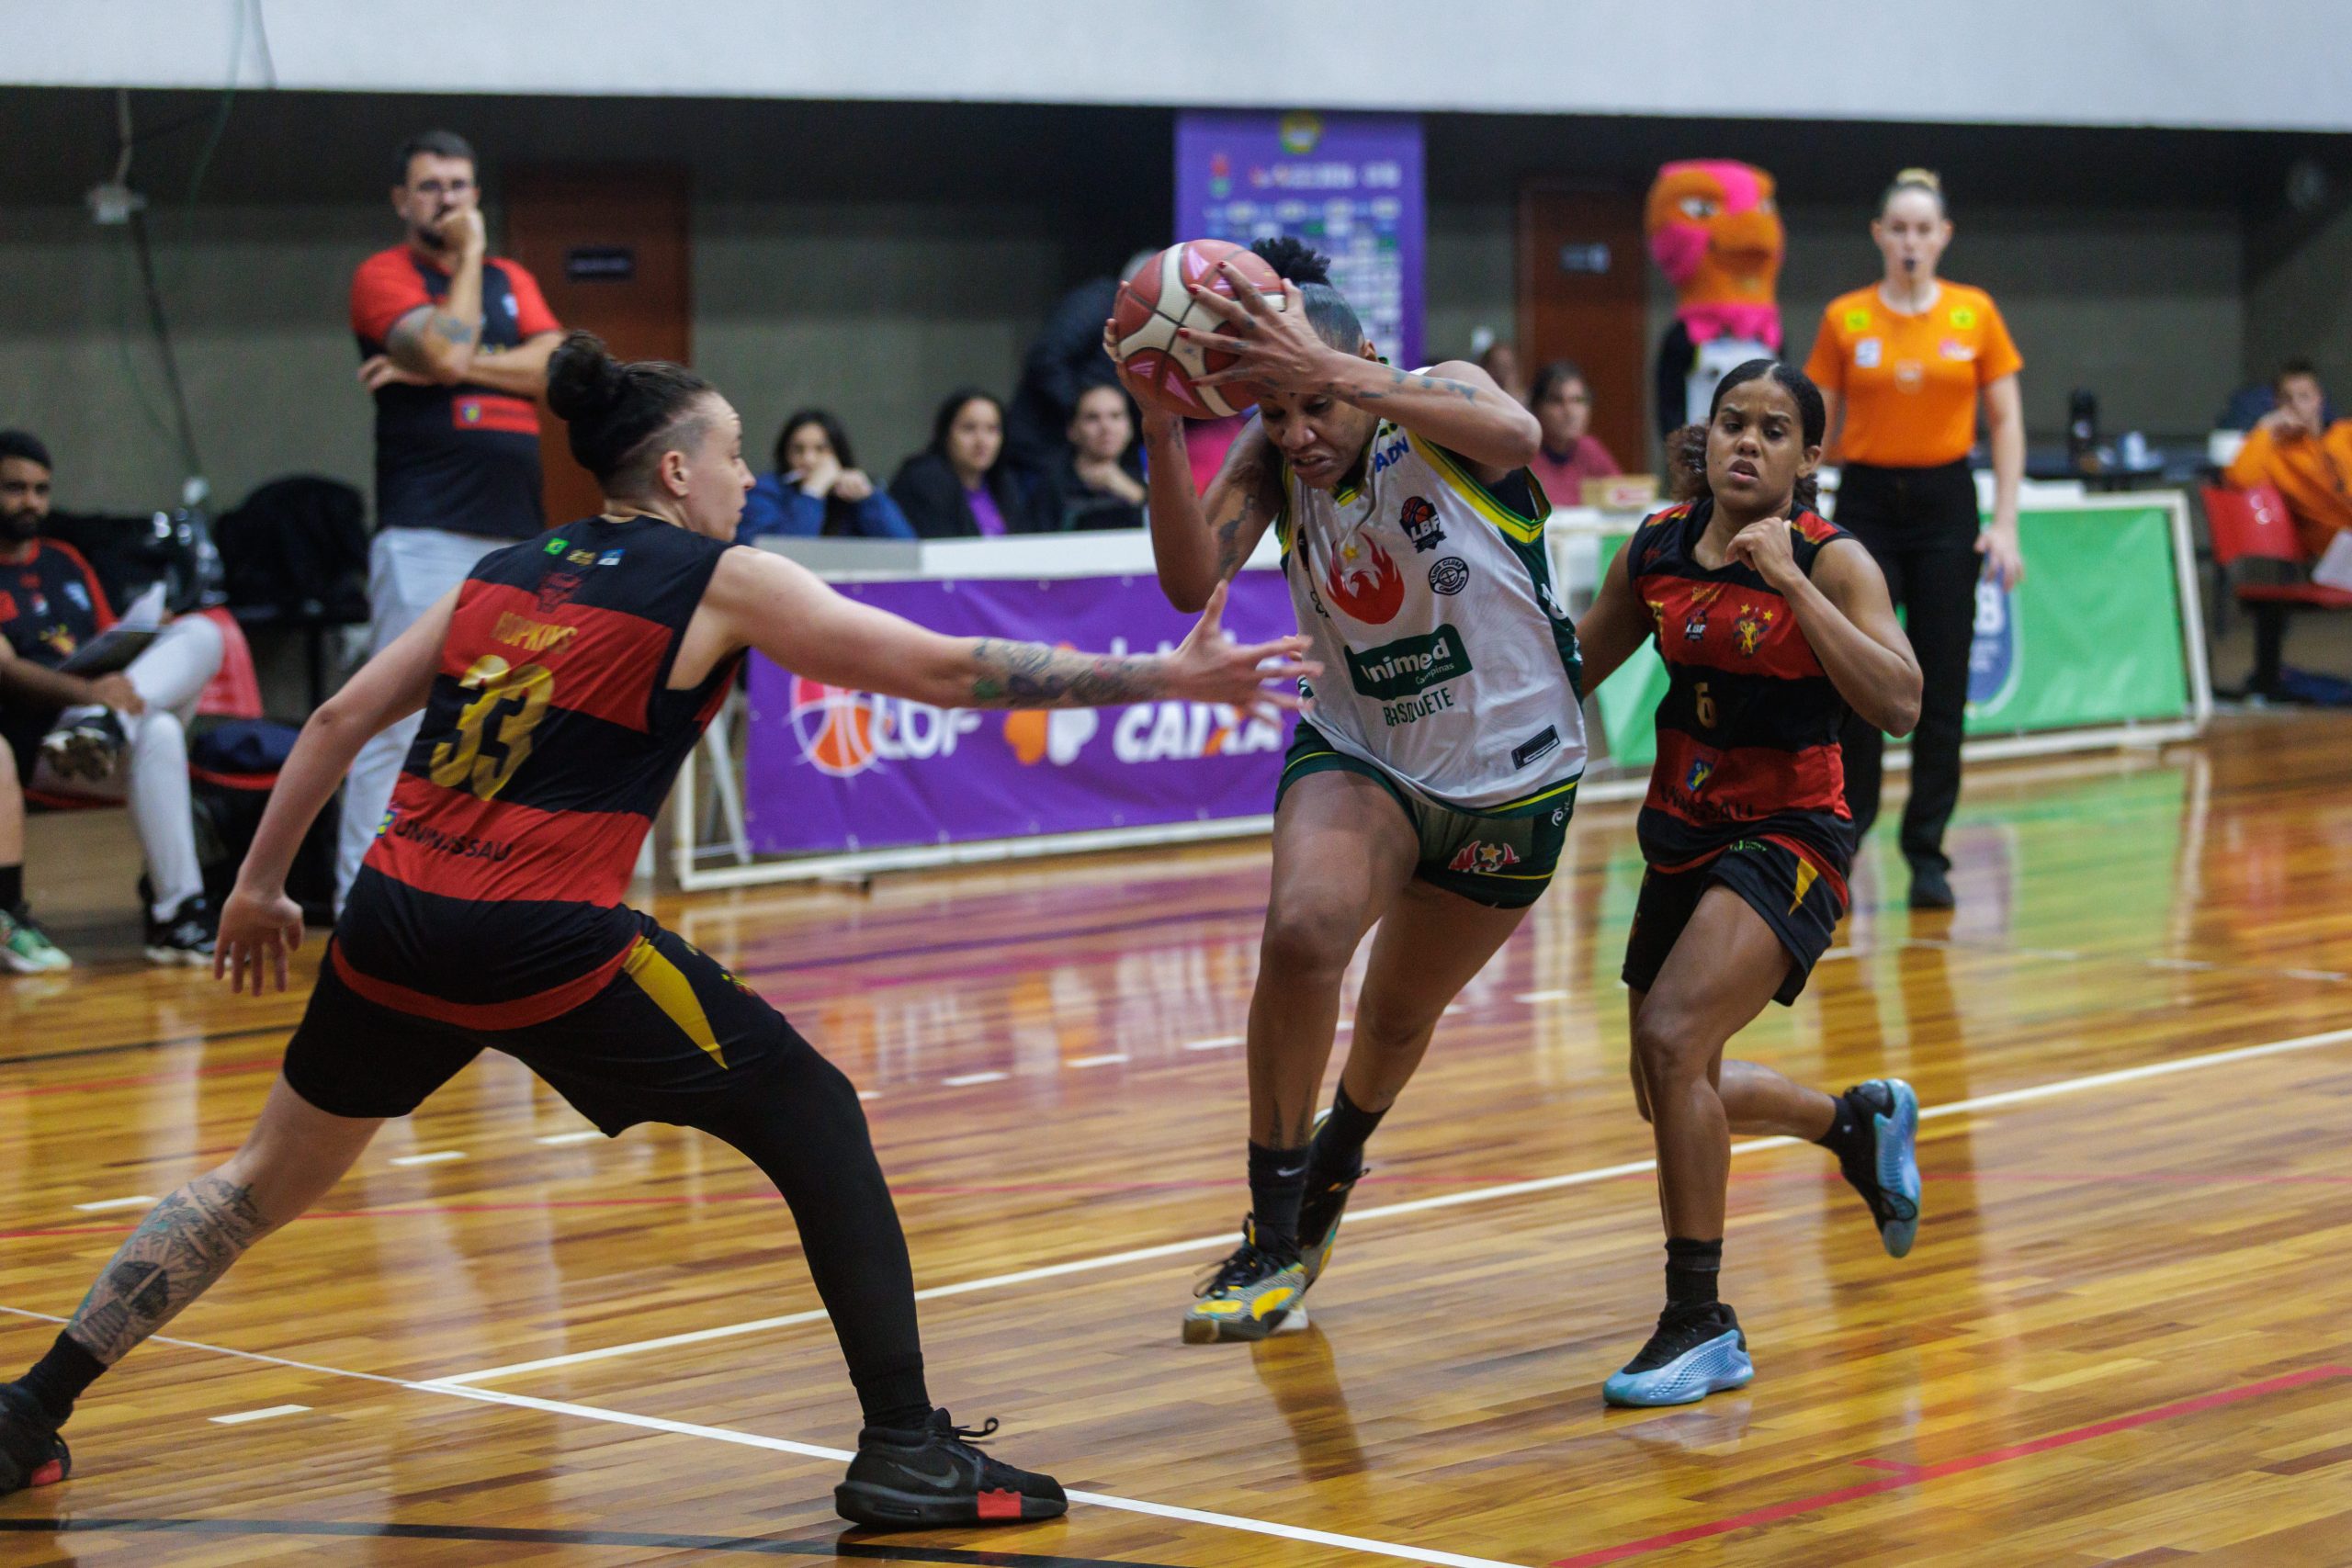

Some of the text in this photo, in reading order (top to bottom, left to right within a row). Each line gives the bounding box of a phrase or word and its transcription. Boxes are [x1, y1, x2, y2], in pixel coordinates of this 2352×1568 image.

[1375, 436, 1409, 473] ADN
[1410, 513, 1441, 543] LBF
[1685, 624, 1706, 634] LBF
[1415, 663, 1454, 685] Campinas
[1382, 687, 1454, 728] BASQUETE
[1693, 682, 1718, 728] 6
[429, 654, 555, 802] 33
